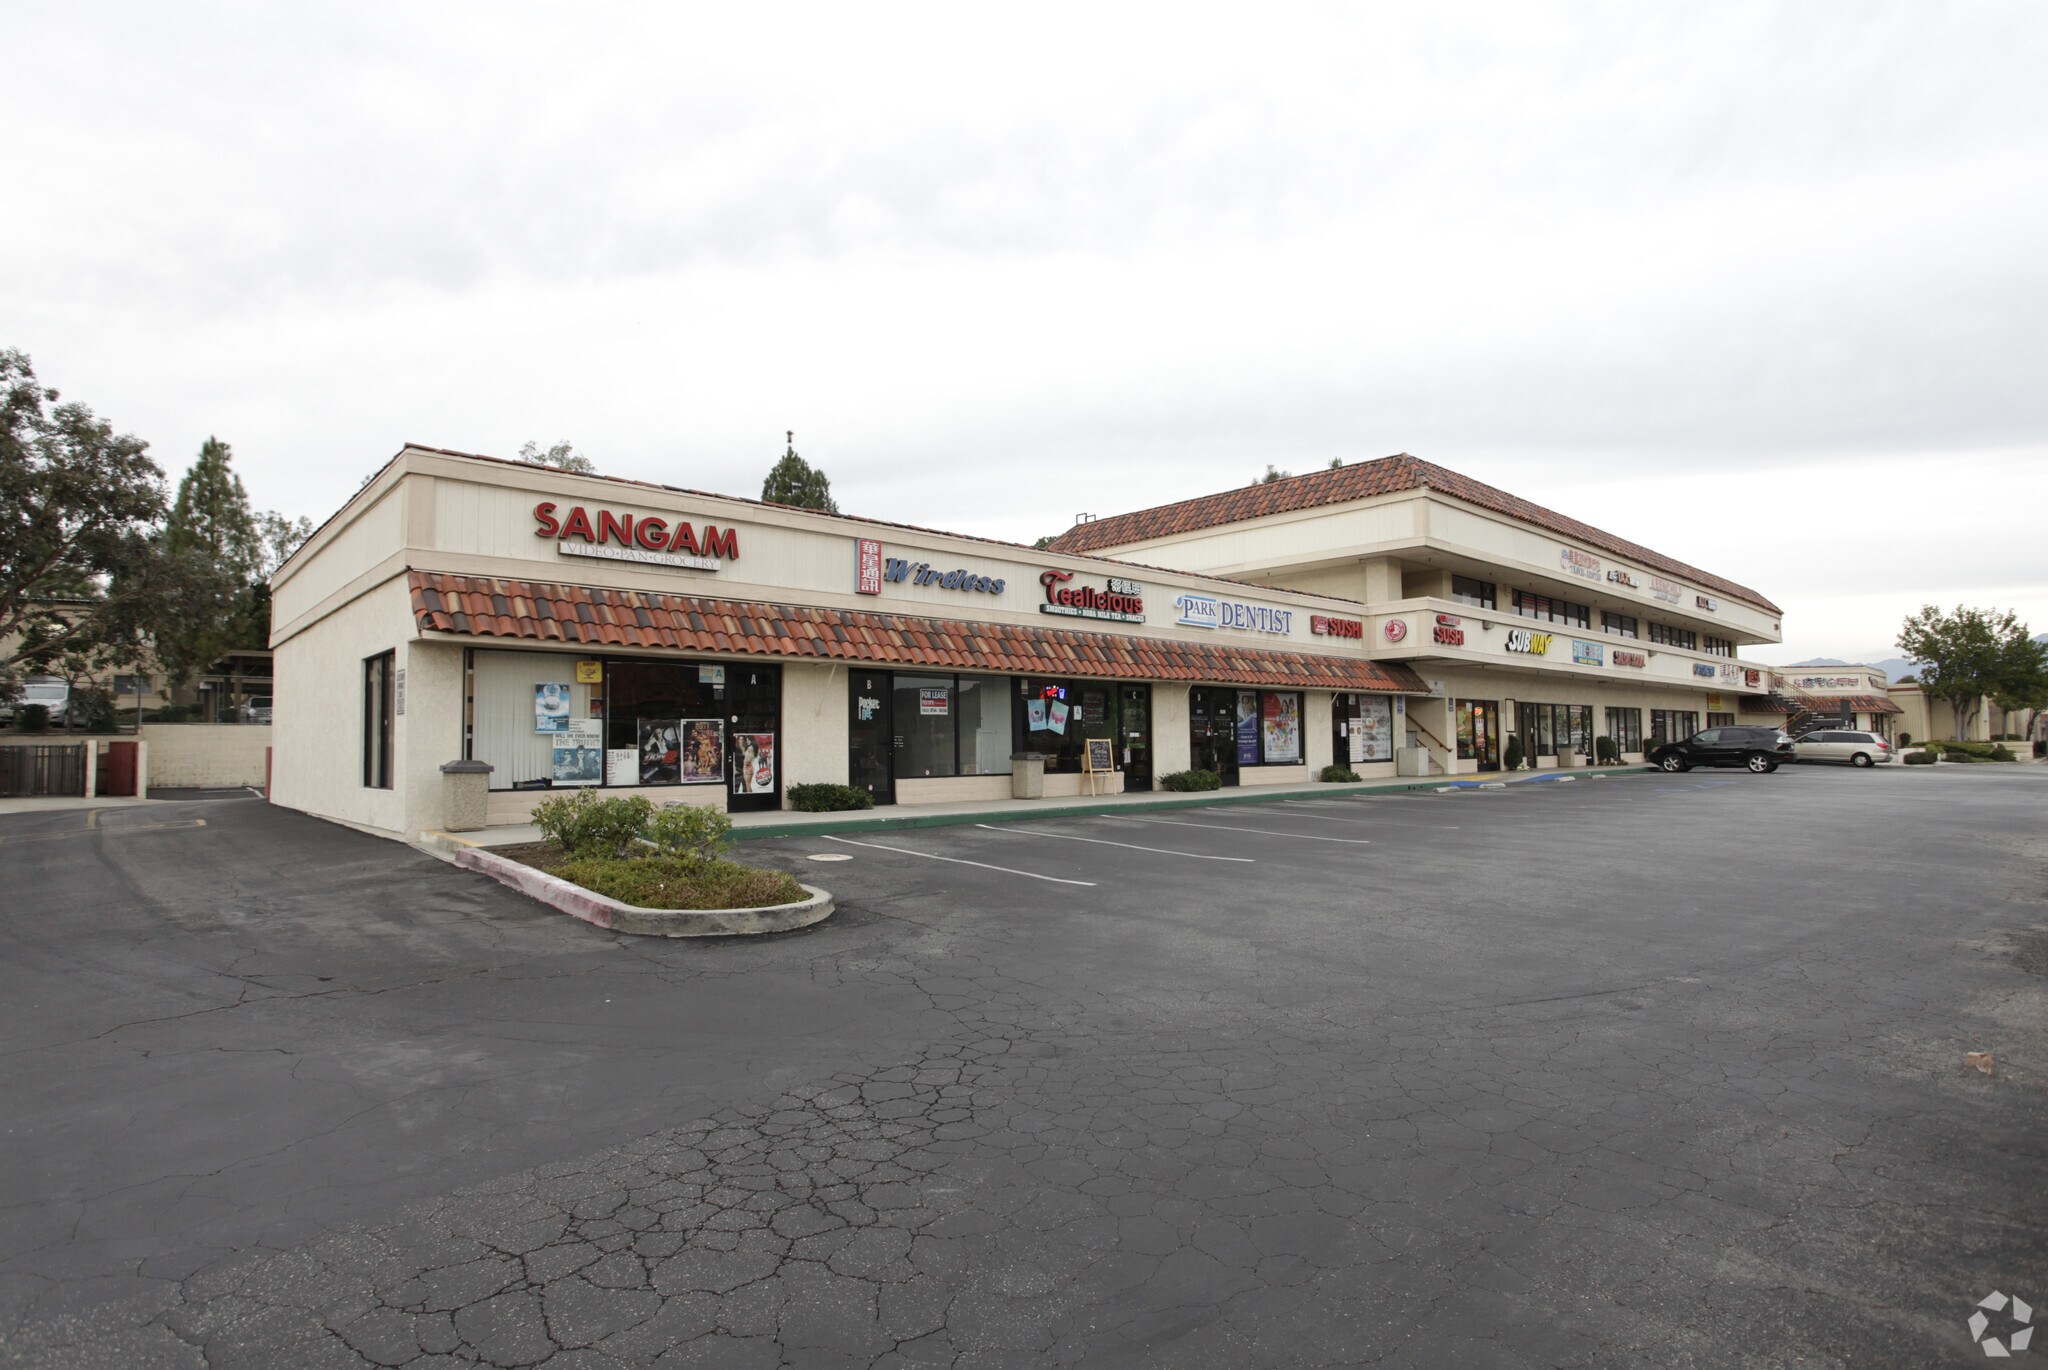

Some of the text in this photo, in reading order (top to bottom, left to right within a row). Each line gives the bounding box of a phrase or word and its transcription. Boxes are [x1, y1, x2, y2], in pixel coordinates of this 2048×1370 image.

[534, 502, 739, 559] SANGAM
[884, 557, 1006, 595] Wireless
[1040, 570, 1143, 613] Tealicious
[1045, 605, 1077, 615] SMOOTHIES
[1097, 611, 1111, 619] MILK
[1111, 612, 1122, 620] TEA
[1221, 601, 1293, 634] DENTIST
[1329, 616, 1363, 639] SUSHI
[1436, 626, 1464, 646] SUSHI
[1507, 629, 1552, 655] SUBWAY
[751, 674, 757, 685] A
[867, 680, 872, 689] B
[921, 690, 947, 699] FOR LEASE
